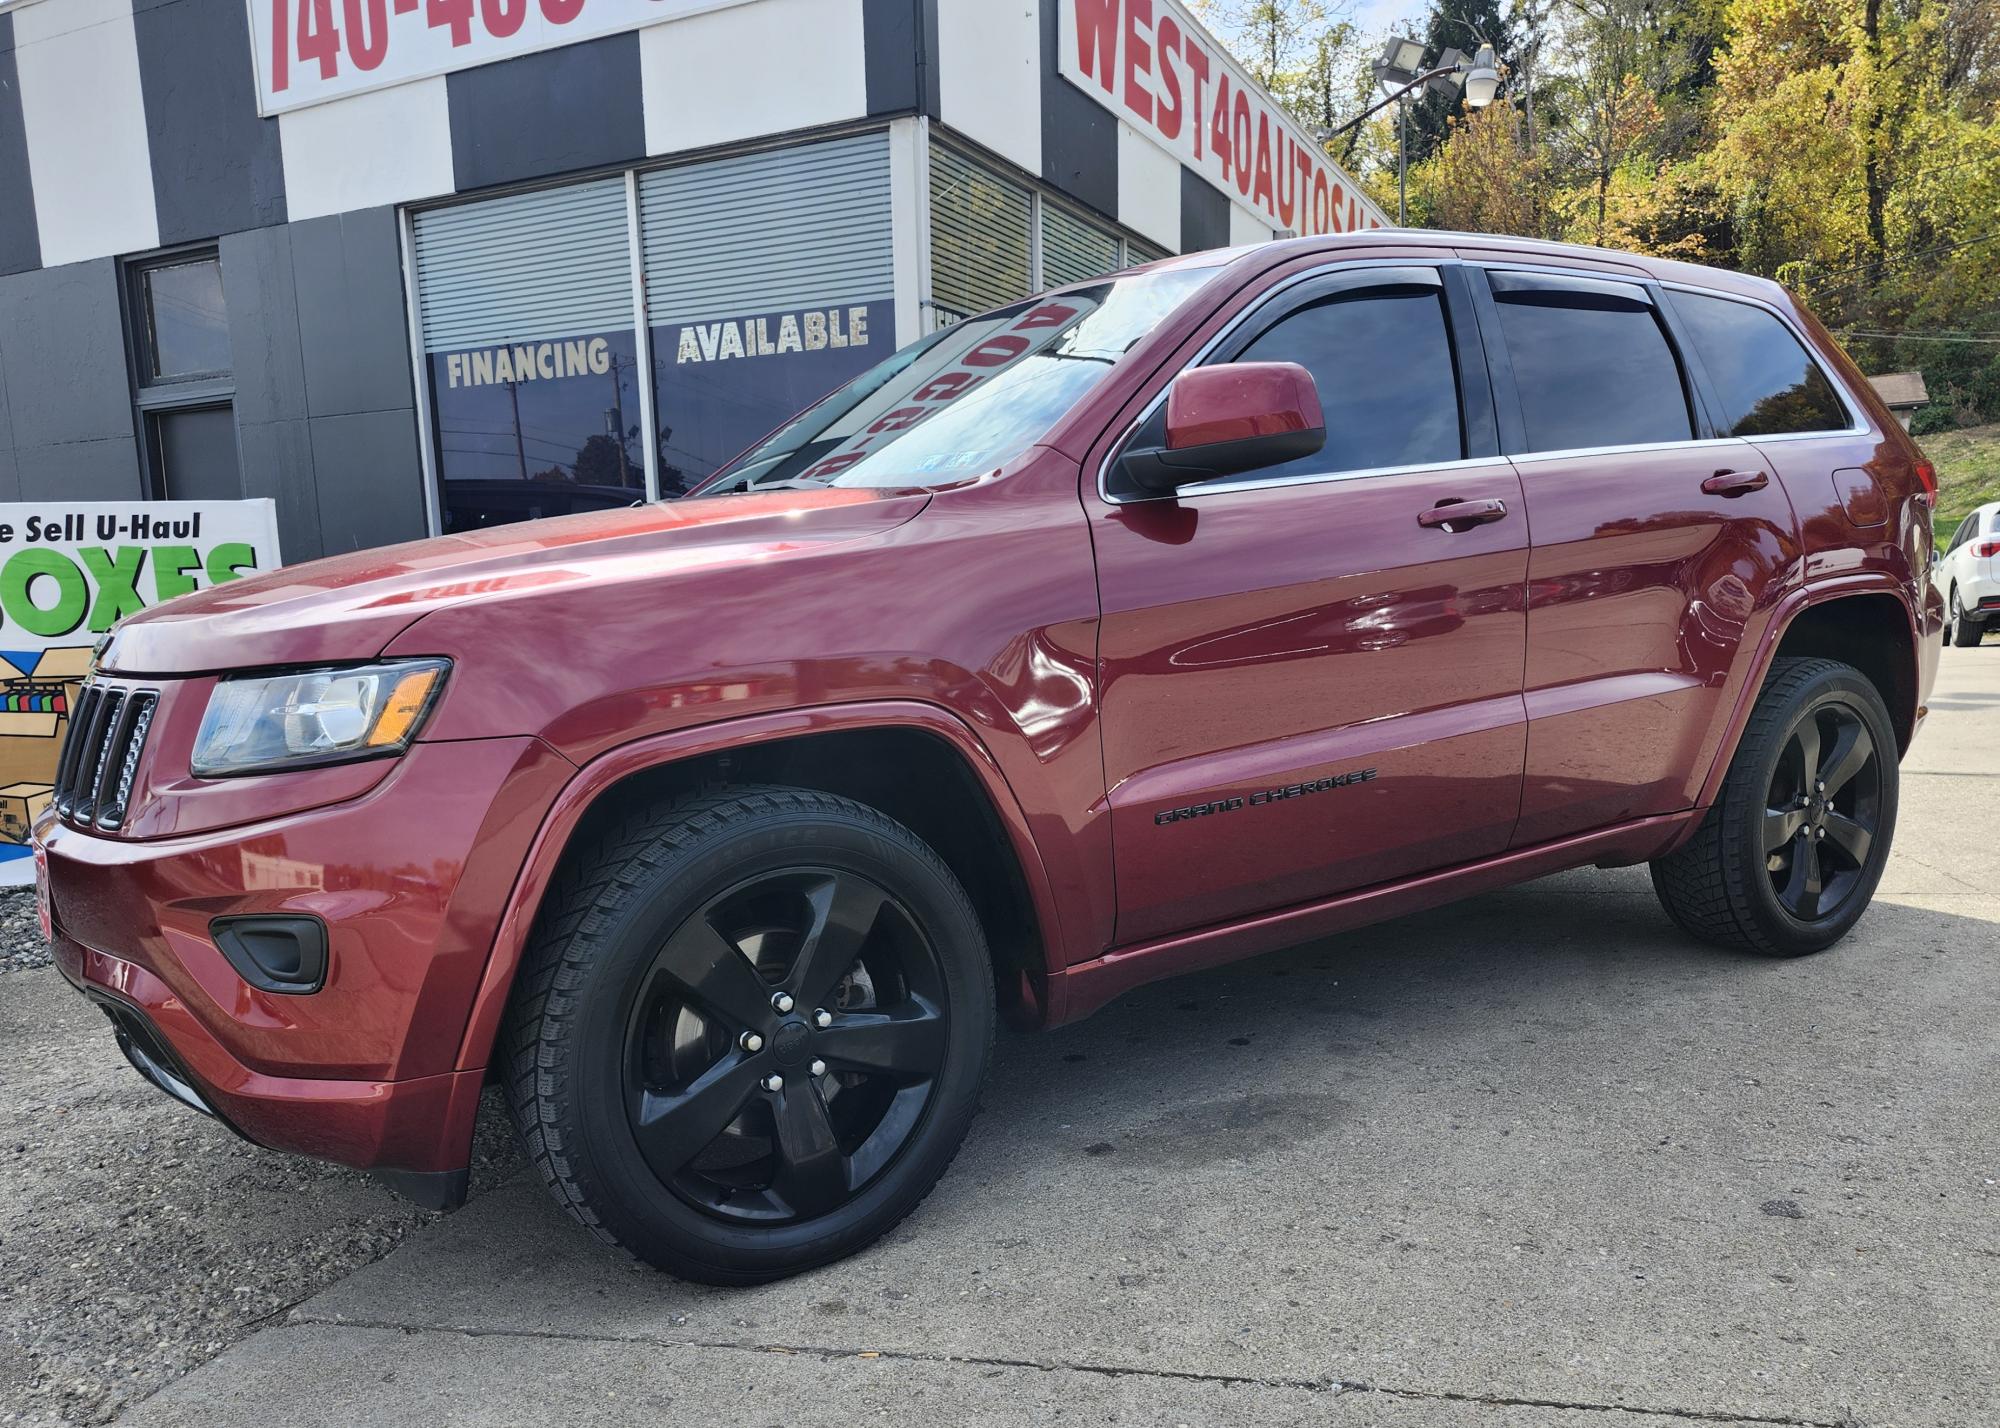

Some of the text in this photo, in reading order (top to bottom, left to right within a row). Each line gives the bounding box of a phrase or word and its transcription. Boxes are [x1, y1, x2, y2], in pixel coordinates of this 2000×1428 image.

[447, 337, 609, 388] FINANCING
[677, 306, 869, 364] AVAILABLE
[0, 511, 201, 543] e Sell U-Haul
[0, 542, 258, 637] OXE
[1154, 767, 1378, 826] GRAND CHEROKEE
